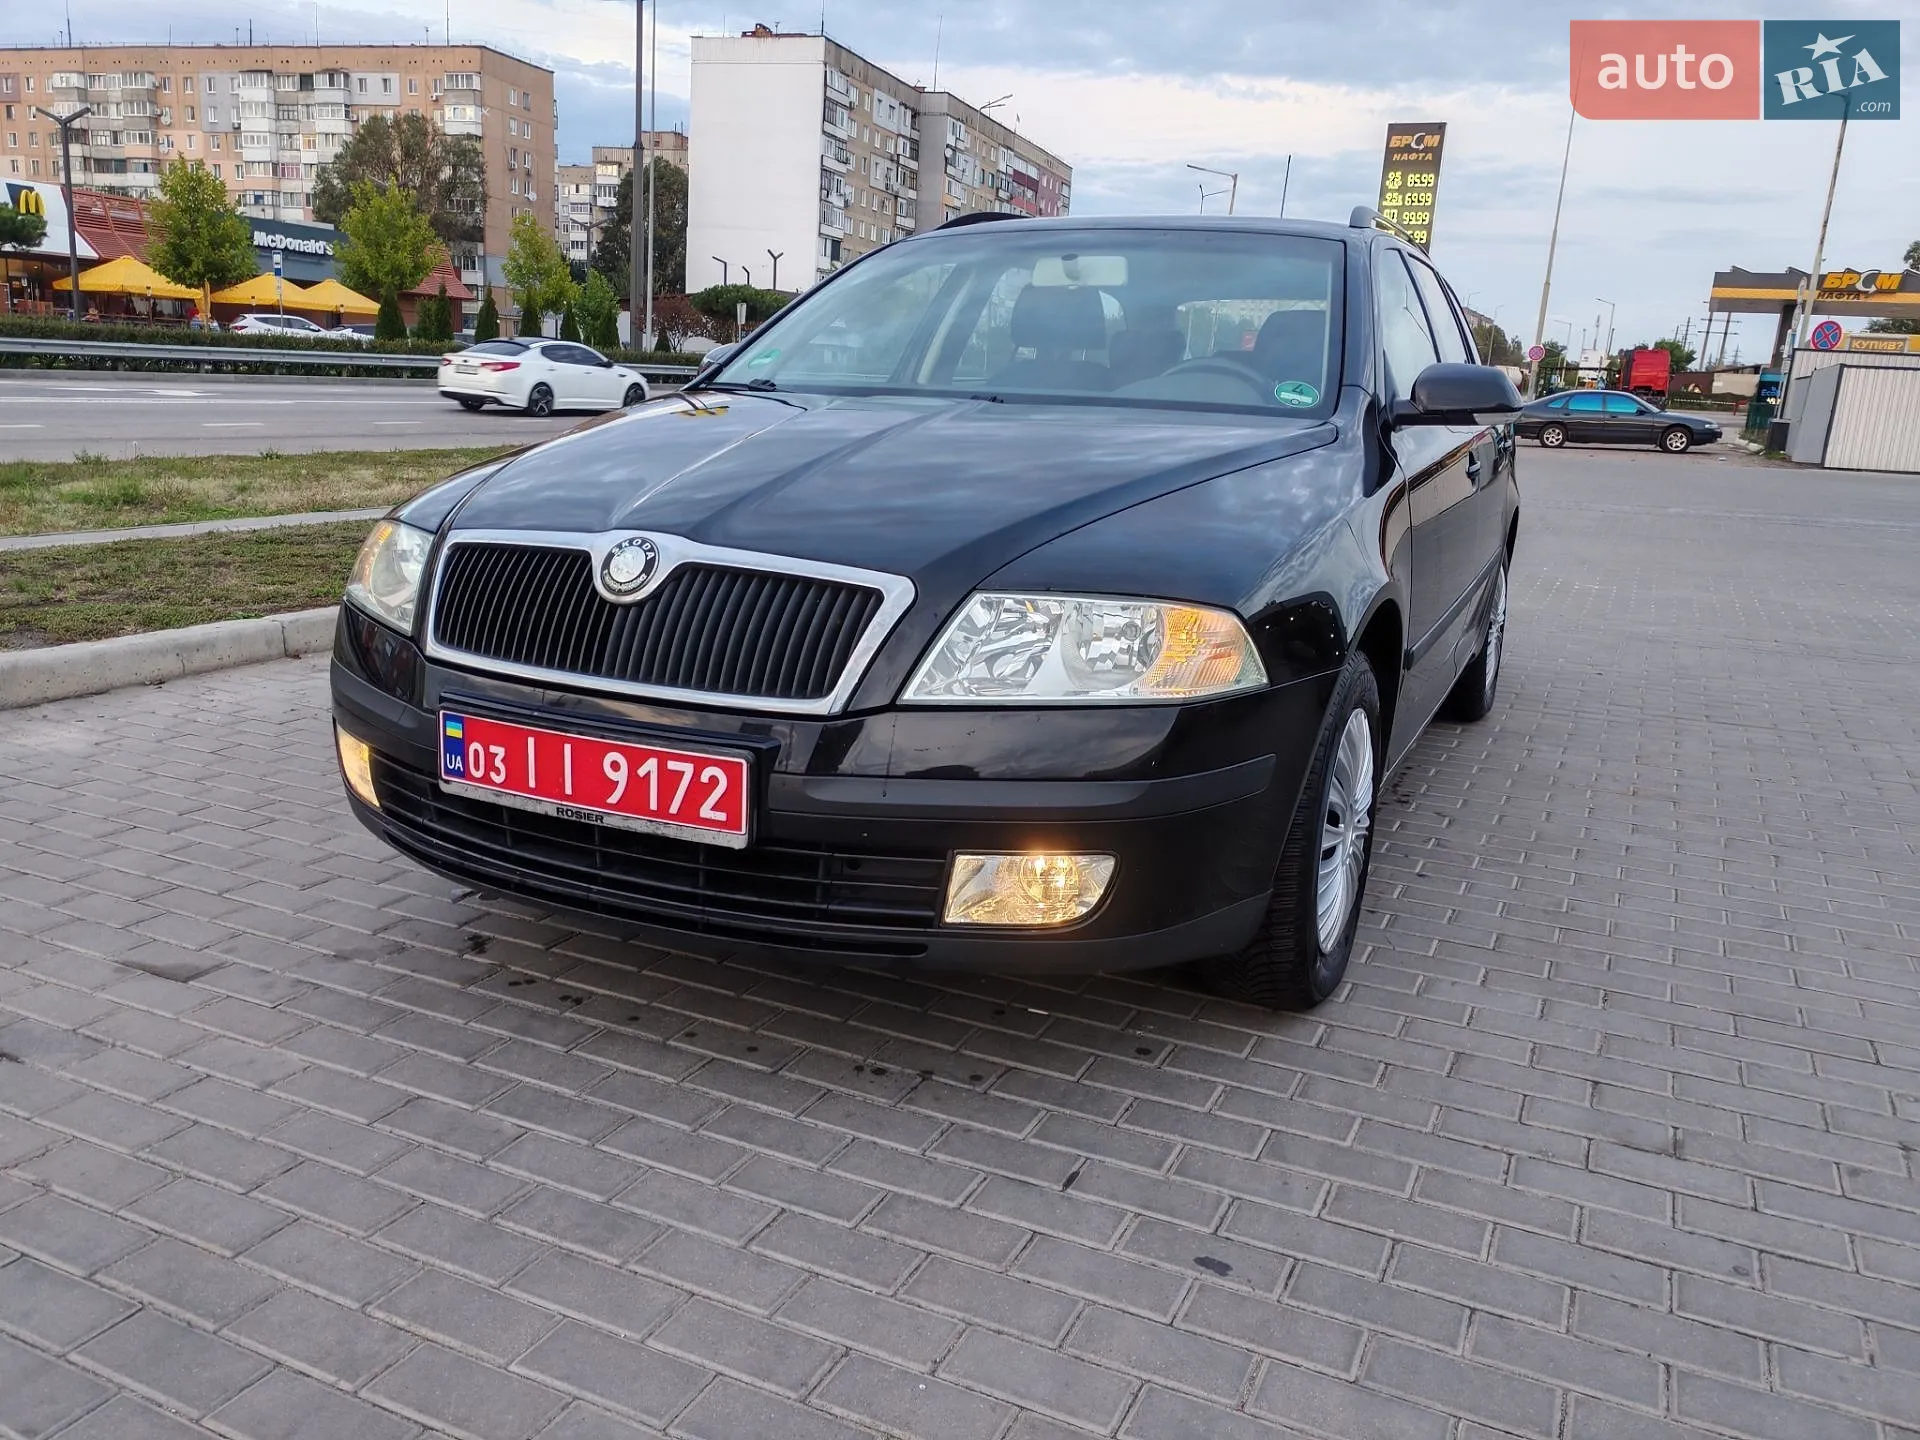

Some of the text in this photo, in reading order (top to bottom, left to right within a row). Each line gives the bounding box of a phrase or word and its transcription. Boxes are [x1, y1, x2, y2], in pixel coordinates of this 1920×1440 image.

[1392, 152, 1433, 161] НАФТА
[253, 231, 334, 256] McDonald's
[1822, 270, 1903, 294] БРСМ
[1816, 292, 1861, 300] НАФТА
[446, 753, 463, 771] UA
[468, 741, 506, 784] 03
[602, 751, 728, 822] 9172
[556, 806, 604, 824] ROSIER
